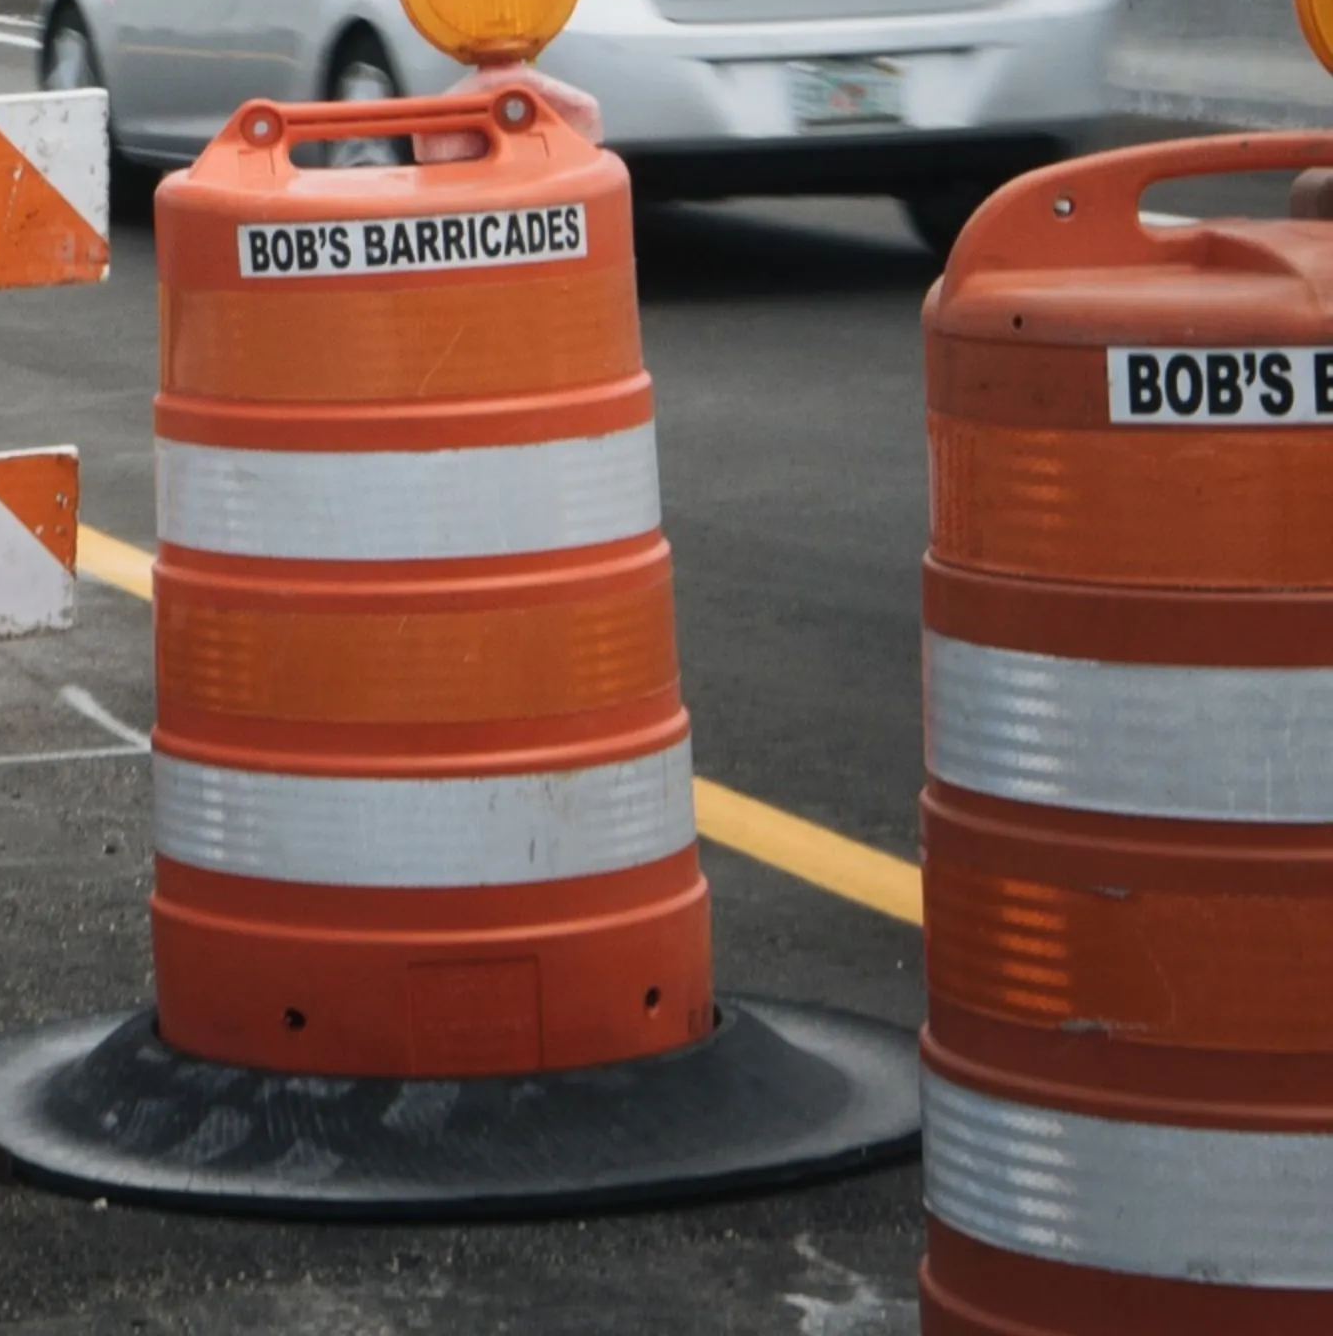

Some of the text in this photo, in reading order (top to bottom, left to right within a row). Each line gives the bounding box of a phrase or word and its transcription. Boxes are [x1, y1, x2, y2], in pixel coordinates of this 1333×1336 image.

[248, 207, 580, 273] BOB'S BARRICADES
[1128, 352, 1295, 417] BOB'S
